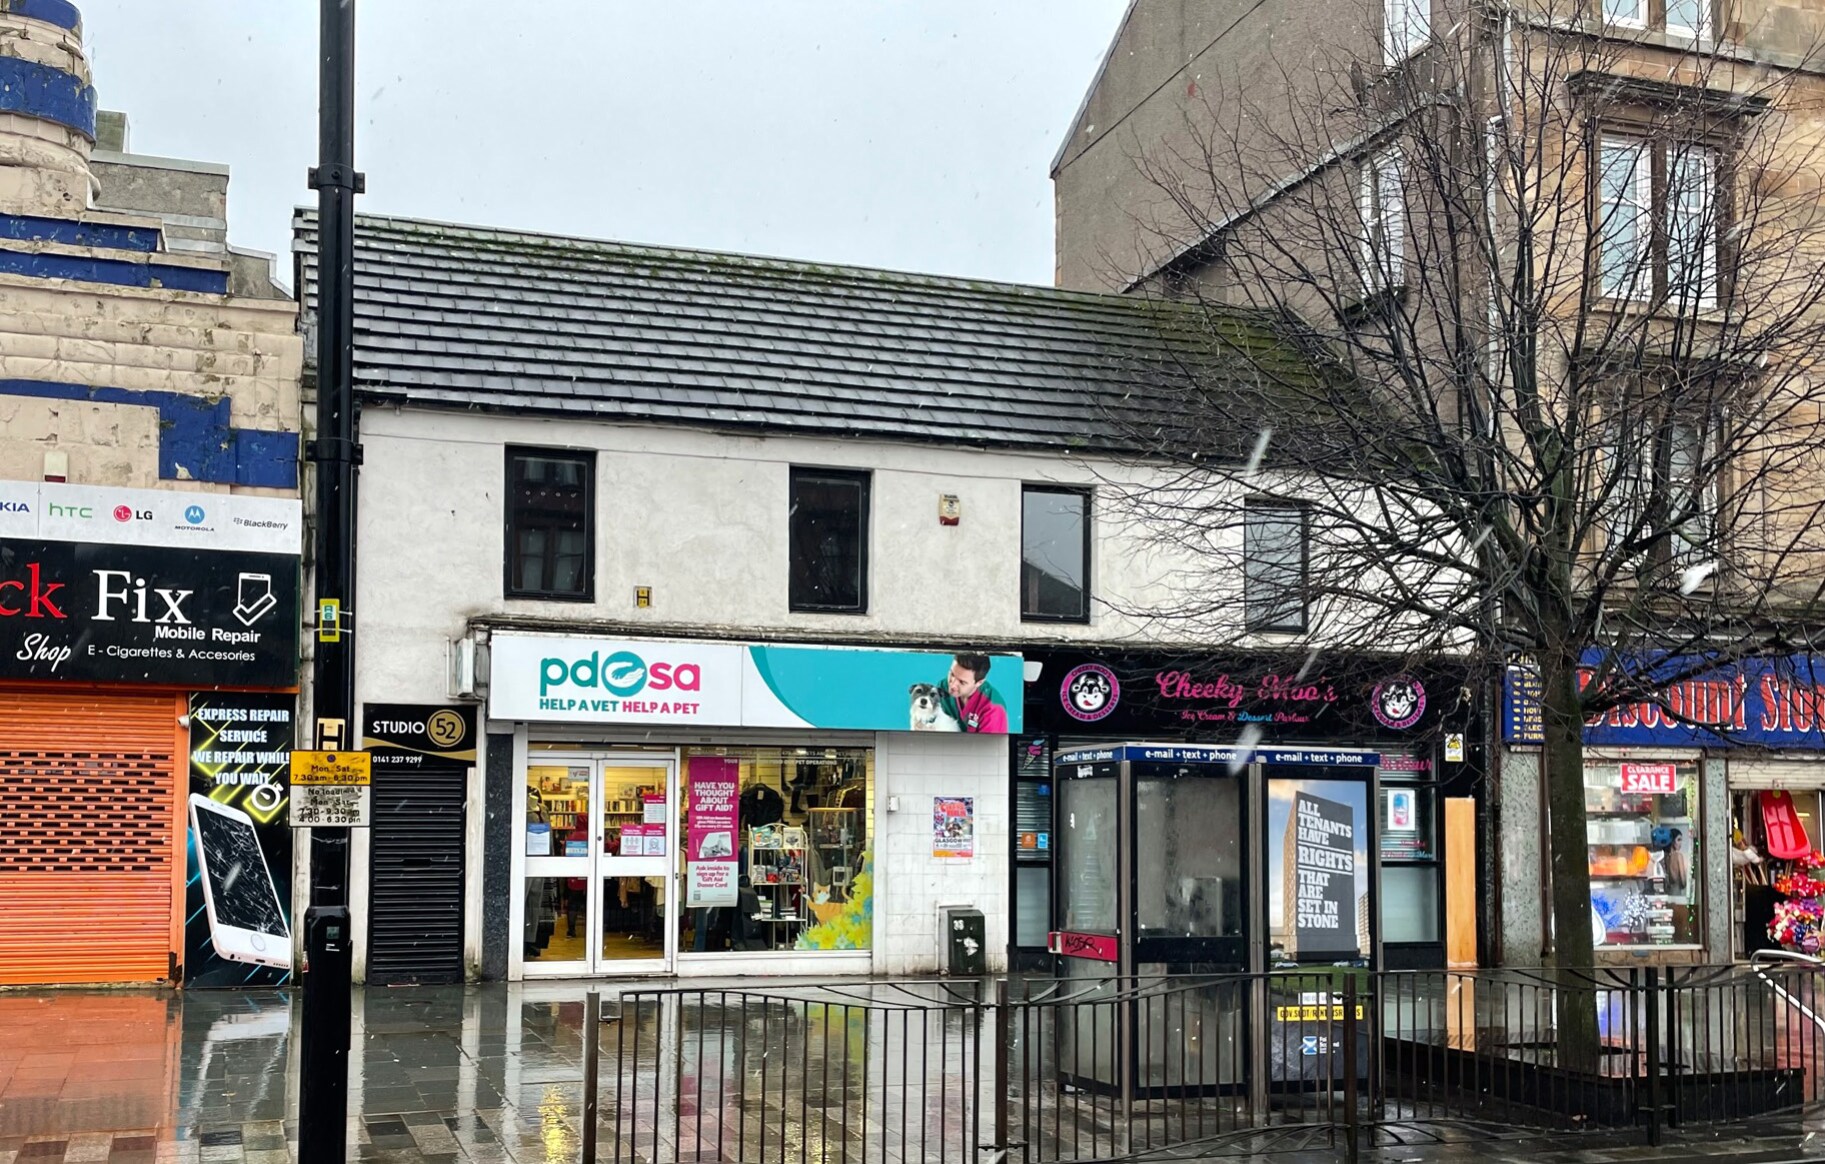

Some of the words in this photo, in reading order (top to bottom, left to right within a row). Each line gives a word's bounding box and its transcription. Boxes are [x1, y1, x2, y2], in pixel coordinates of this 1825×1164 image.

[0, 502, 30, 512] KIA
[136, 510, 153, 520] LG
[243, 519, 288, 531] BlackBerry
[0, 563, 68, 619] ck
[91, 569, 194, 624] Fix
[155, 625, 206, 640] Mobile
[212, 628, 261, 645] Repair
[16, 633, 72, 672] Shop
[88, 645, 95, 655] E
[107, 645, 173, 660] Cigarettes
[176, 648, 185, 658] &
[189, 648, 256, 661] Accesories
[1156, 671, 1244, 708] Cheeky
[539, 698, 576, 711] HELP
[578, 700, 589, 711] A
[591, 700, 619, 712] VET
[622, 701, 658, 713] HELP
[660, 702, 670, 713] A
[673, 702, 699, 714] PET
[198, 708, 247, 720] EXPRESS
[249, 709, 289, 721] REPAIR
[373, 721, 425, 734] STUDIO
[436, 718, 456, 739] 52
[219, 730, 268, 743] SERVICE
[193, 751, 212, 763] WE
[214, 751, 254, 763] REPAIR
[372, 755, 389, 763] 0141
[391, 755, 404, 763] 237
[405, 756, 422, 764] 9299
[1062, 751, 1079, 762] e-mail
[1096, 750, 1113, 759] phone
[1145, 750, 1173, 758] e-mail
[1182, 751, 1200, 760] text
[1210, 751, 1237, 761] phone
[1275, 753, 1302, 761] e-mail
[1311, 754, 1328, 763] text
[1336, 753, 1362, 764] phone
[311, 765, 329, 773] Mon
[336, 764, 350, 773] Sat
[1627, 766, 1670, 774] CLEARANCE
[215, 773, 238, 785] YOU
[240, 773, 270, 785] WAIT
[1627, 774, 1670, 791] SALE
[694, 782, 717, 790] HAVE
[718, 782, 735, 790] YOU
[695, 789, 734, 797] THOUGHT
[695, 804, 714, 812] GIFT
[715, 804, 734, 812] AID?
[1298, 799, 1320, 817] ALL
[1298, 813, 1352, 838] TENANTS
[1298, 827, 1329, 845] HAVE
[1298, 846, 1353, 871] RIGHTS
[1298, 870, 1330, 886] THAT
[1298, 885, 1323, 899] ARE
[1298, 900, 1322, 914] SET
[1324, 901, 1338, 914] IN
[1298, 914, 1339, 928] STONE
